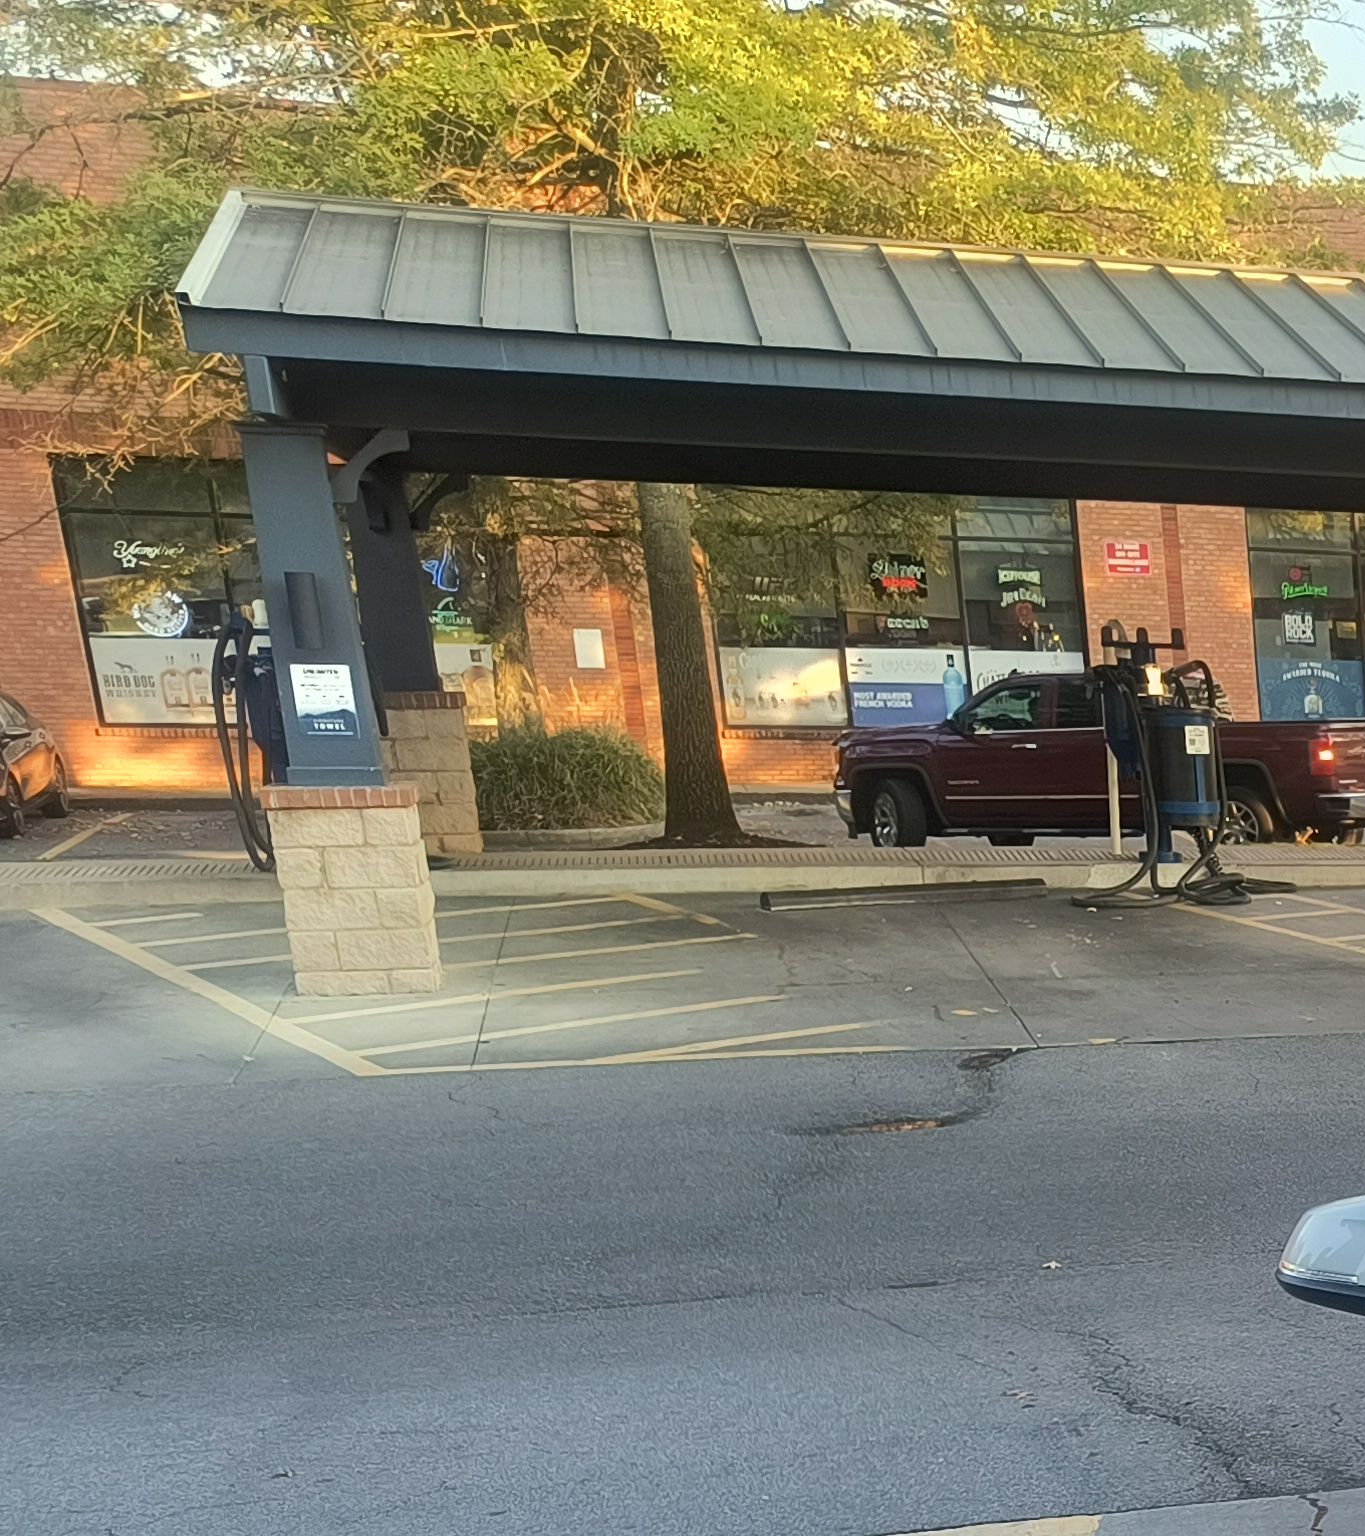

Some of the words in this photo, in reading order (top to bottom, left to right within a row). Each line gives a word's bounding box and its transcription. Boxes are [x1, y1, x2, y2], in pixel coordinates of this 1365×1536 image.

[1285, 614, 1312, 627] BOLD
[1285, 626, 1313, 640] ROCK
[102, 673, 131, 688] BIRD
[133, 675, 155, 688] DOG
